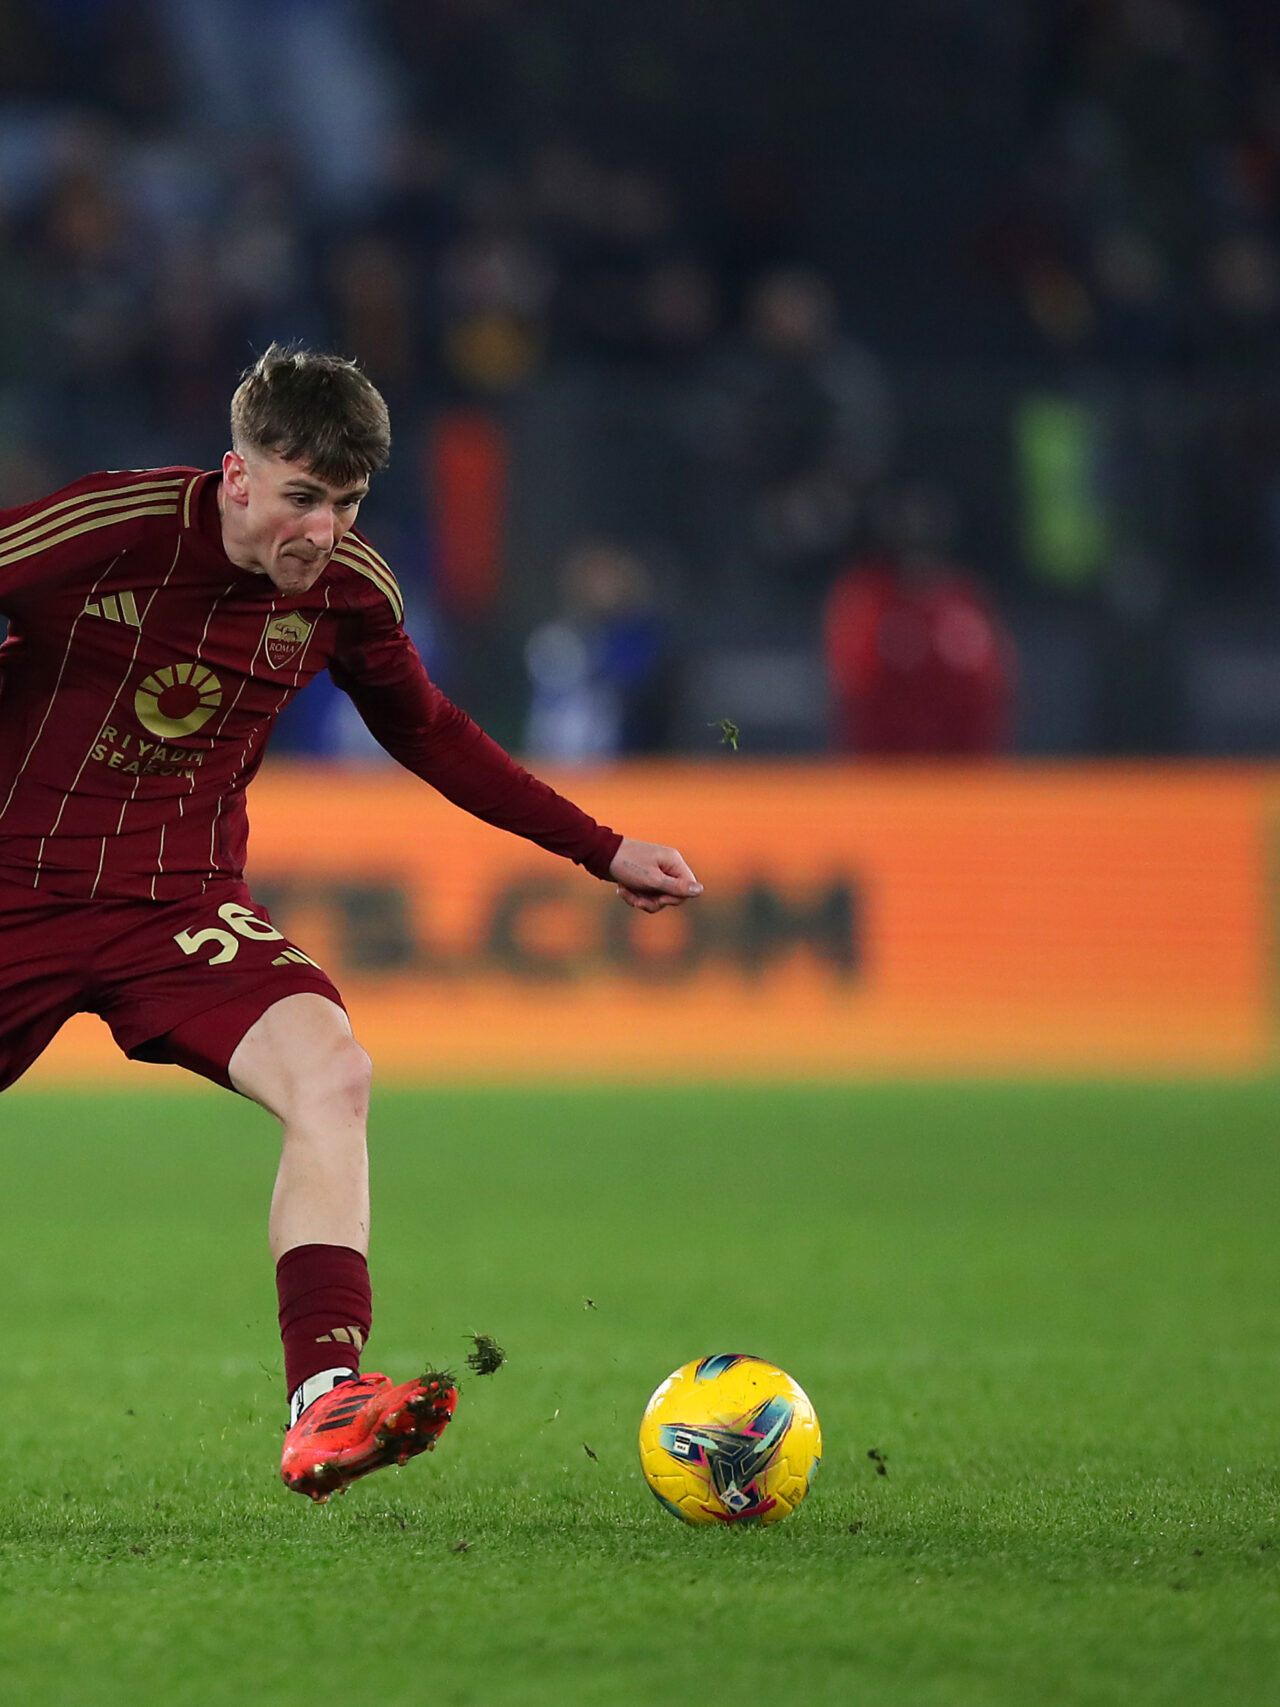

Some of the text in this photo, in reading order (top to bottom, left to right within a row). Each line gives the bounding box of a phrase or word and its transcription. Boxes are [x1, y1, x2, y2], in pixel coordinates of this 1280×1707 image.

[269, 642, 296, 654] ROMA
[101, 724, 204, 766] RIYADH
[173, 902, 286, 966] 56
